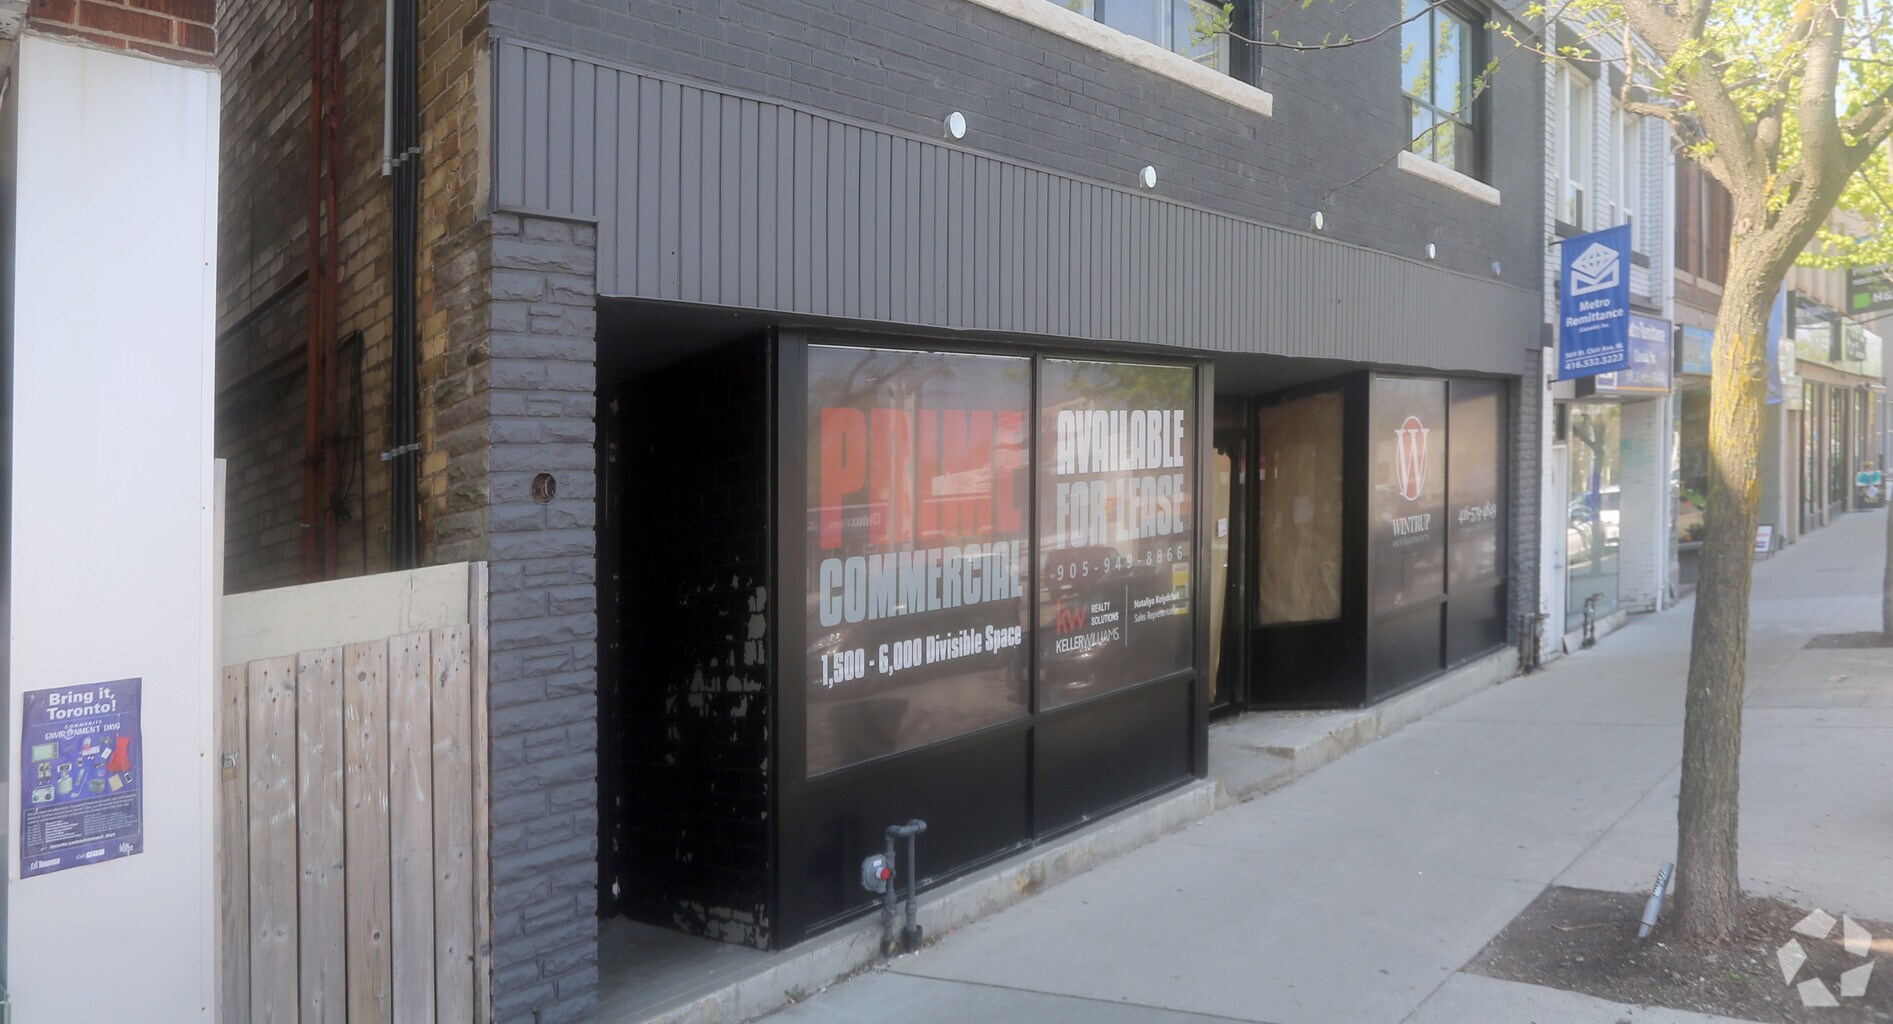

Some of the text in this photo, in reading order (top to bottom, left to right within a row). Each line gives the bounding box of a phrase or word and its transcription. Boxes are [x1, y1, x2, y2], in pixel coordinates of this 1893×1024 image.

[1579, 298, 1610, 312] Metro
[1566, 308, 1624, 327] Remittance
[1565, 353, 1624, 370] 416.532.3223
[1057, 409, 1185, 475] AVAILABLE
[820, 406, 1024, 549] PRIME
[1056, 474, 1185, 550] FOR LEASE
[820, 540, 1023, 627] COMMERCIAL
[1091, 601, 1111, 614] REALTY
[1134, 611, 1147, 623] Sales
[1091, 612, 1120, 626] SOLUTIONS
[821, 648, 865, 688] 1,500
[878, 637, 922, 676] 6,000
[926, 628, 983, 664] Divisible
[985, 624, 1022, 655] Space
[49, 687, 115, 706] Bring it,
[46, 699, 116, 720] Toronto!
[45, 722, 121, 740] ENVIRONMENT DAYS
[64, 720, 102, 729] COMMUNITY
